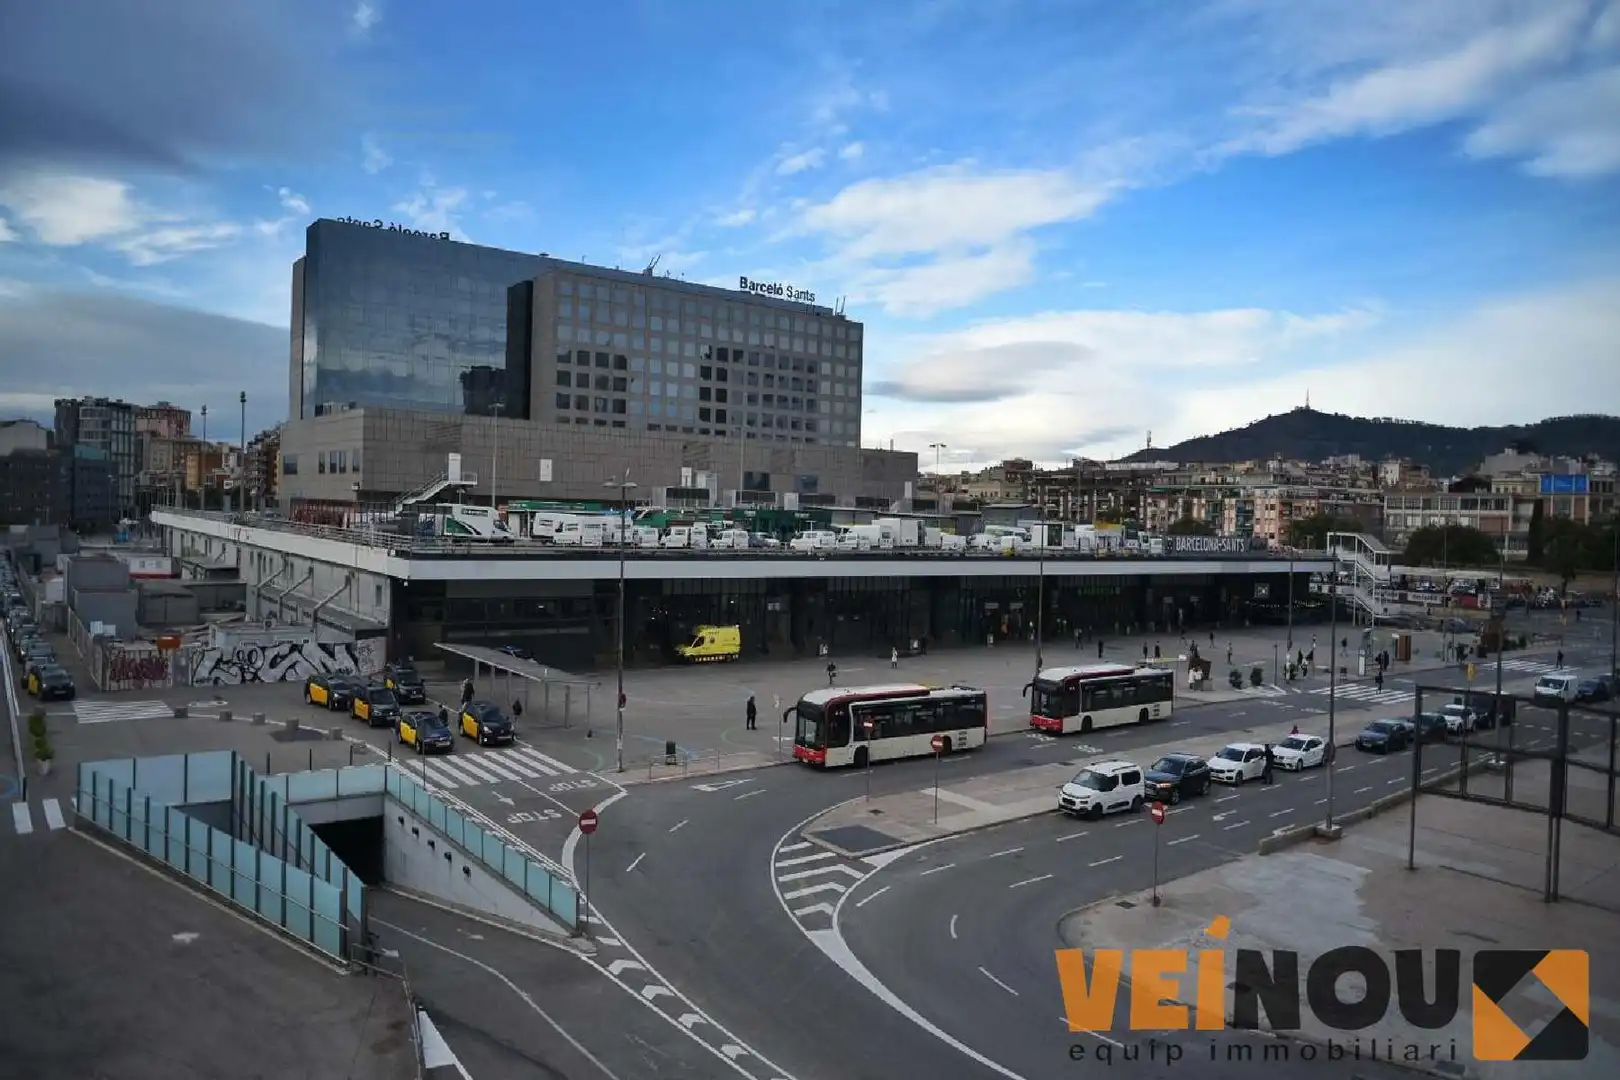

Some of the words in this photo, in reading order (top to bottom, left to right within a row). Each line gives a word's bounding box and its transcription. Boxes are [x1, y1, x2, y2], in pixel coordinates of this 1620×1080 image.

[740, 276, 783, 295] Barceló
[786, 285, 815, 302] Sants
[507, 808, 562, 823] STOP
